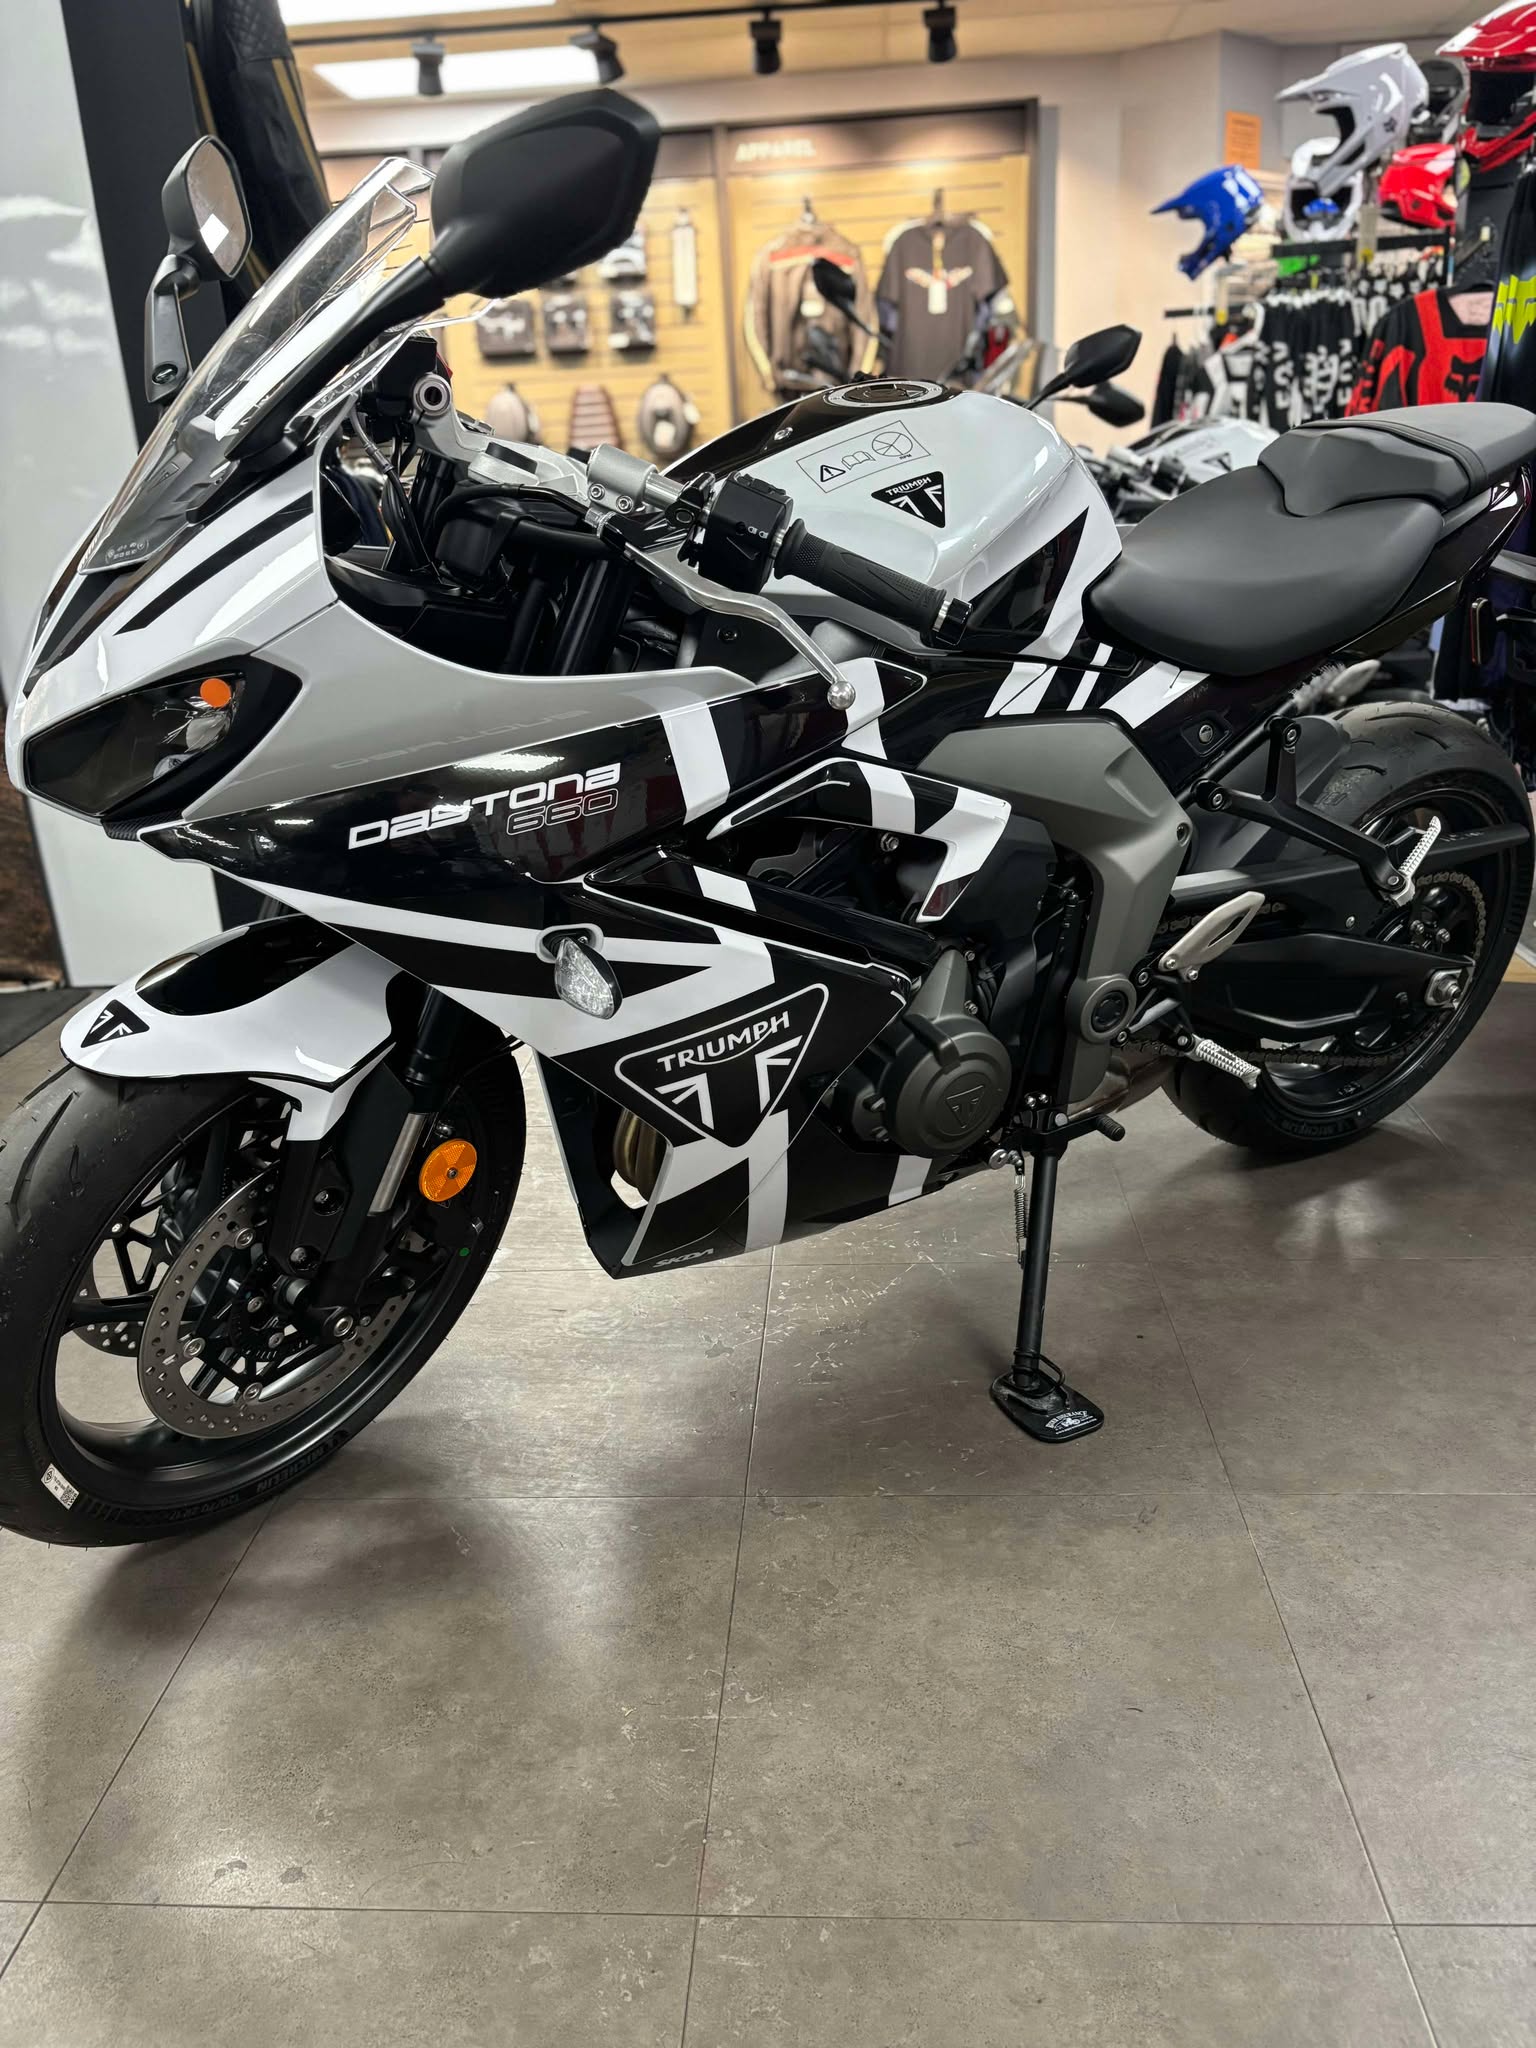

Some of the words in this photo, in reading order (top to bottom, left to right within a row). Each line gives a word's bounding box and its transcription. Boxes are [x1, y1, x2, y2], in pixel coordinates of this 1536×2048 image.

[885, 477, 932, 496] TRIUMPH
[506, 788, 619, 836] 660
[657, 1010, 790, 1073] TRIUMPH
